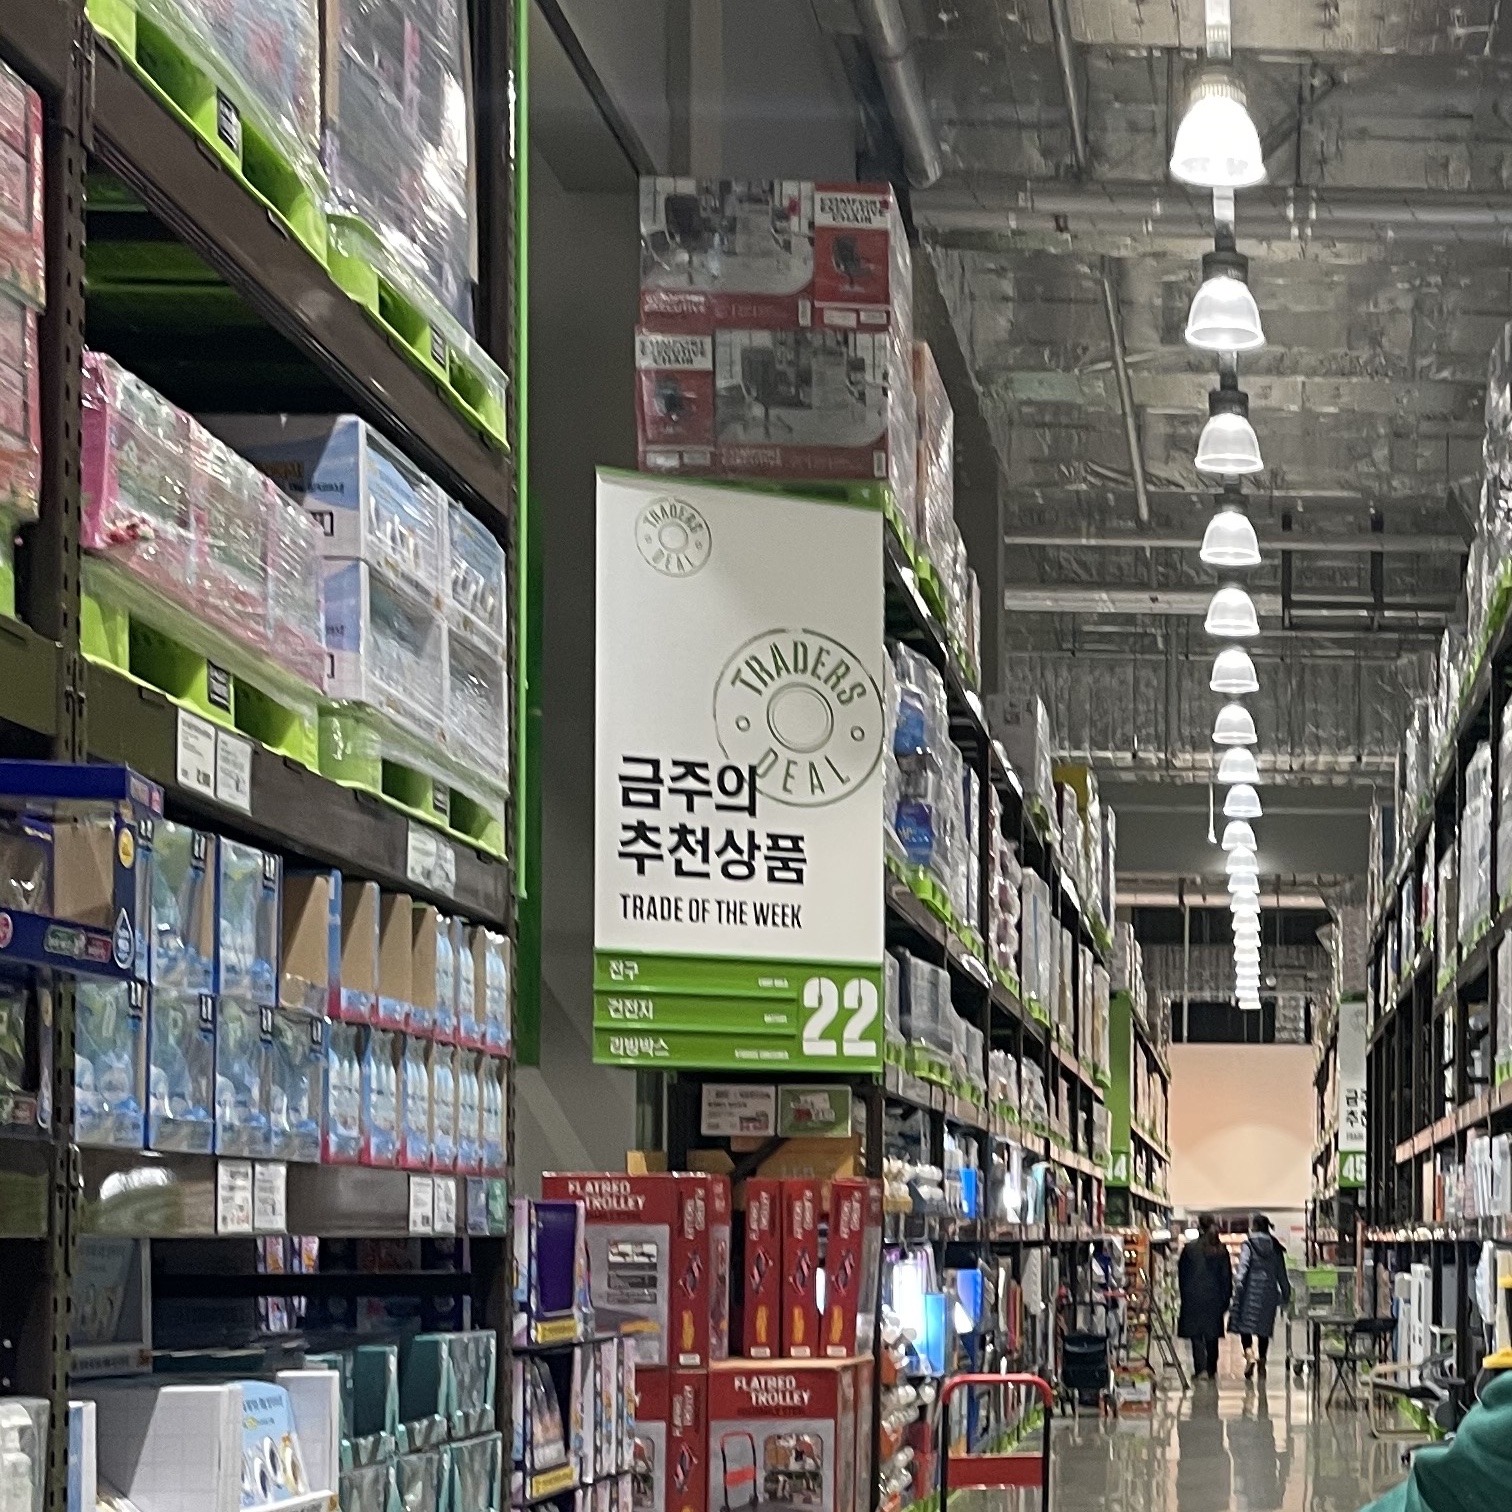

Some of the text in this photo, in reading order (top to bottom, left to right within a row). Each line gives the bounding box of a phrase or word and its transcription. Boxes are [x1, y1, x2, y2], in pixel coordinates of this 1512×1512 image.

[731, 640, 867, 706] TRADERS
[618, 754, 757, 818] 금주의
[755, 746, 850, 796] DEAL
[618, 819, 807, 886] 추천상품
[619, 892, 803, 929] TRADE OF THE WEEK
[609, 960, 640, 981] 전구
[608, 997, 654, 1020] 건전지
[802, 975, 879, 1058] 22
[734, 1375, 797, 1392] FLATBED
[751, 1388, 811, 1407] TROLLEY
